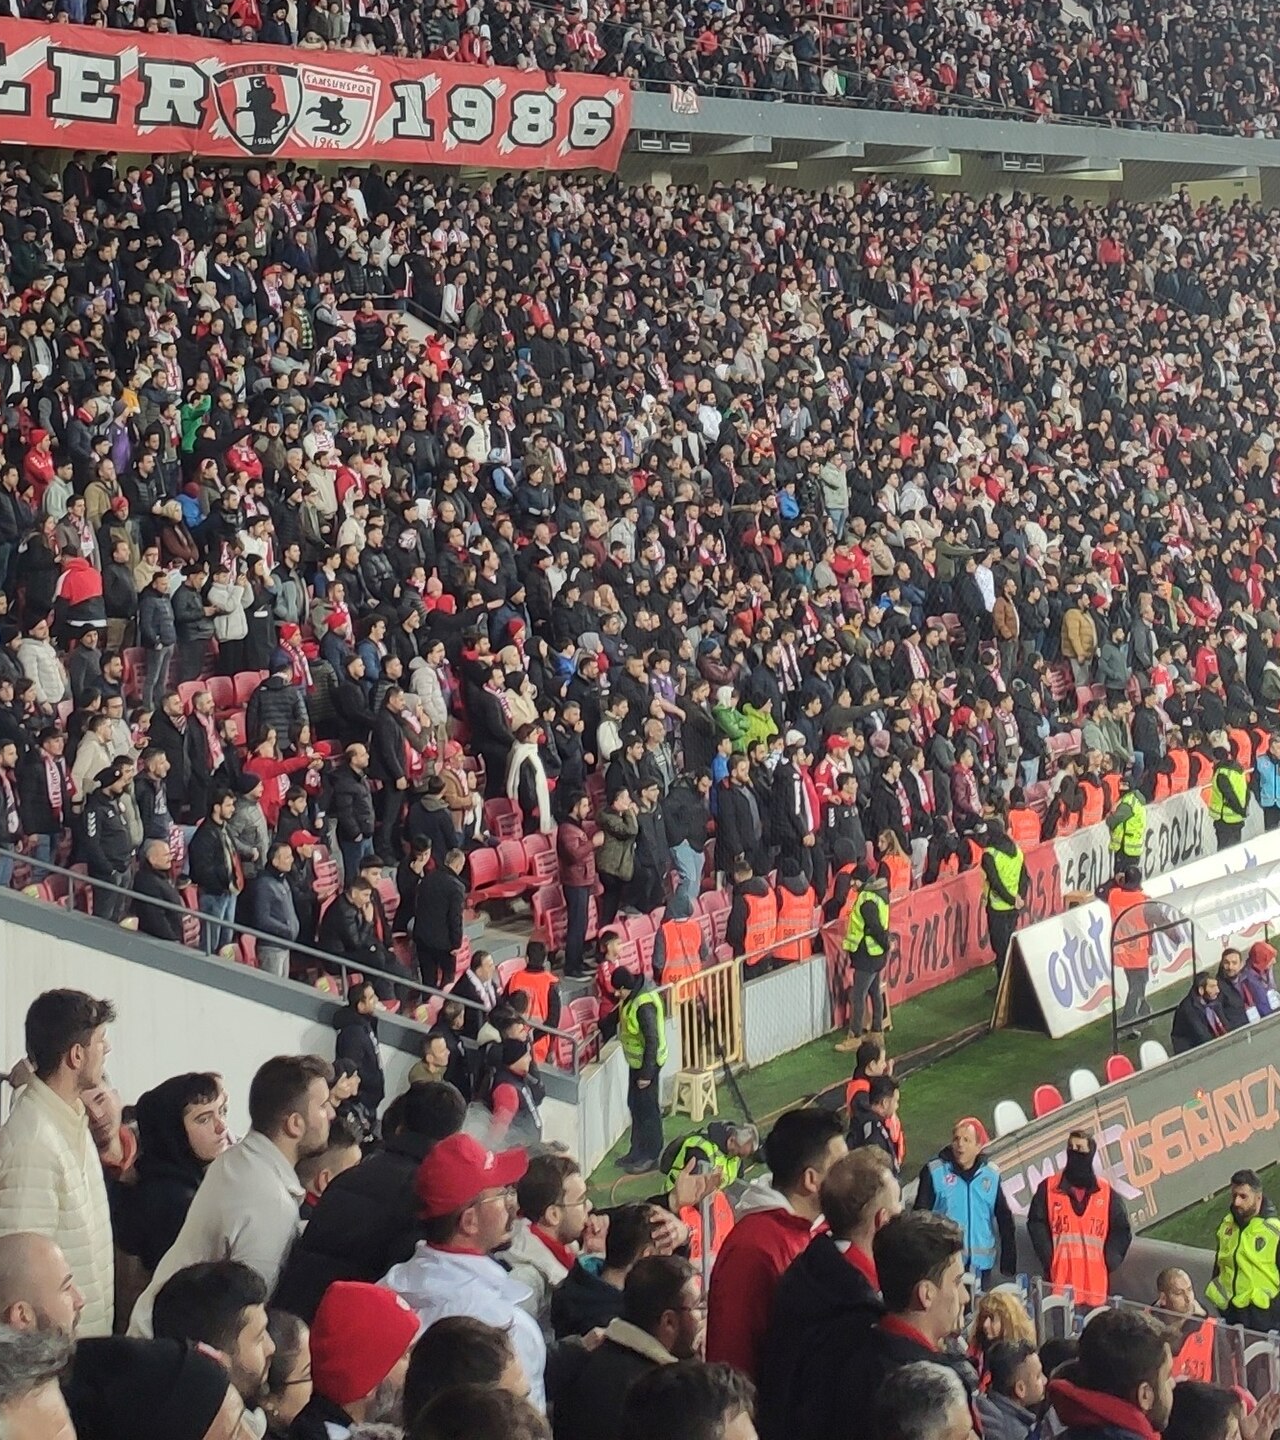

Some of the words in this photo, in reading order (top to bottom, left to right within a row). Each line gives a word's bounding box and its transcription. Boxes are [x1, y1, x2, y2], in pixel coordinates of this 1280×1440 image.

[305, 73, 372, 95] SAMSUNSPOR
[392, 79, 617, 151] 1986
[312, 134, 341, 149] 1965
